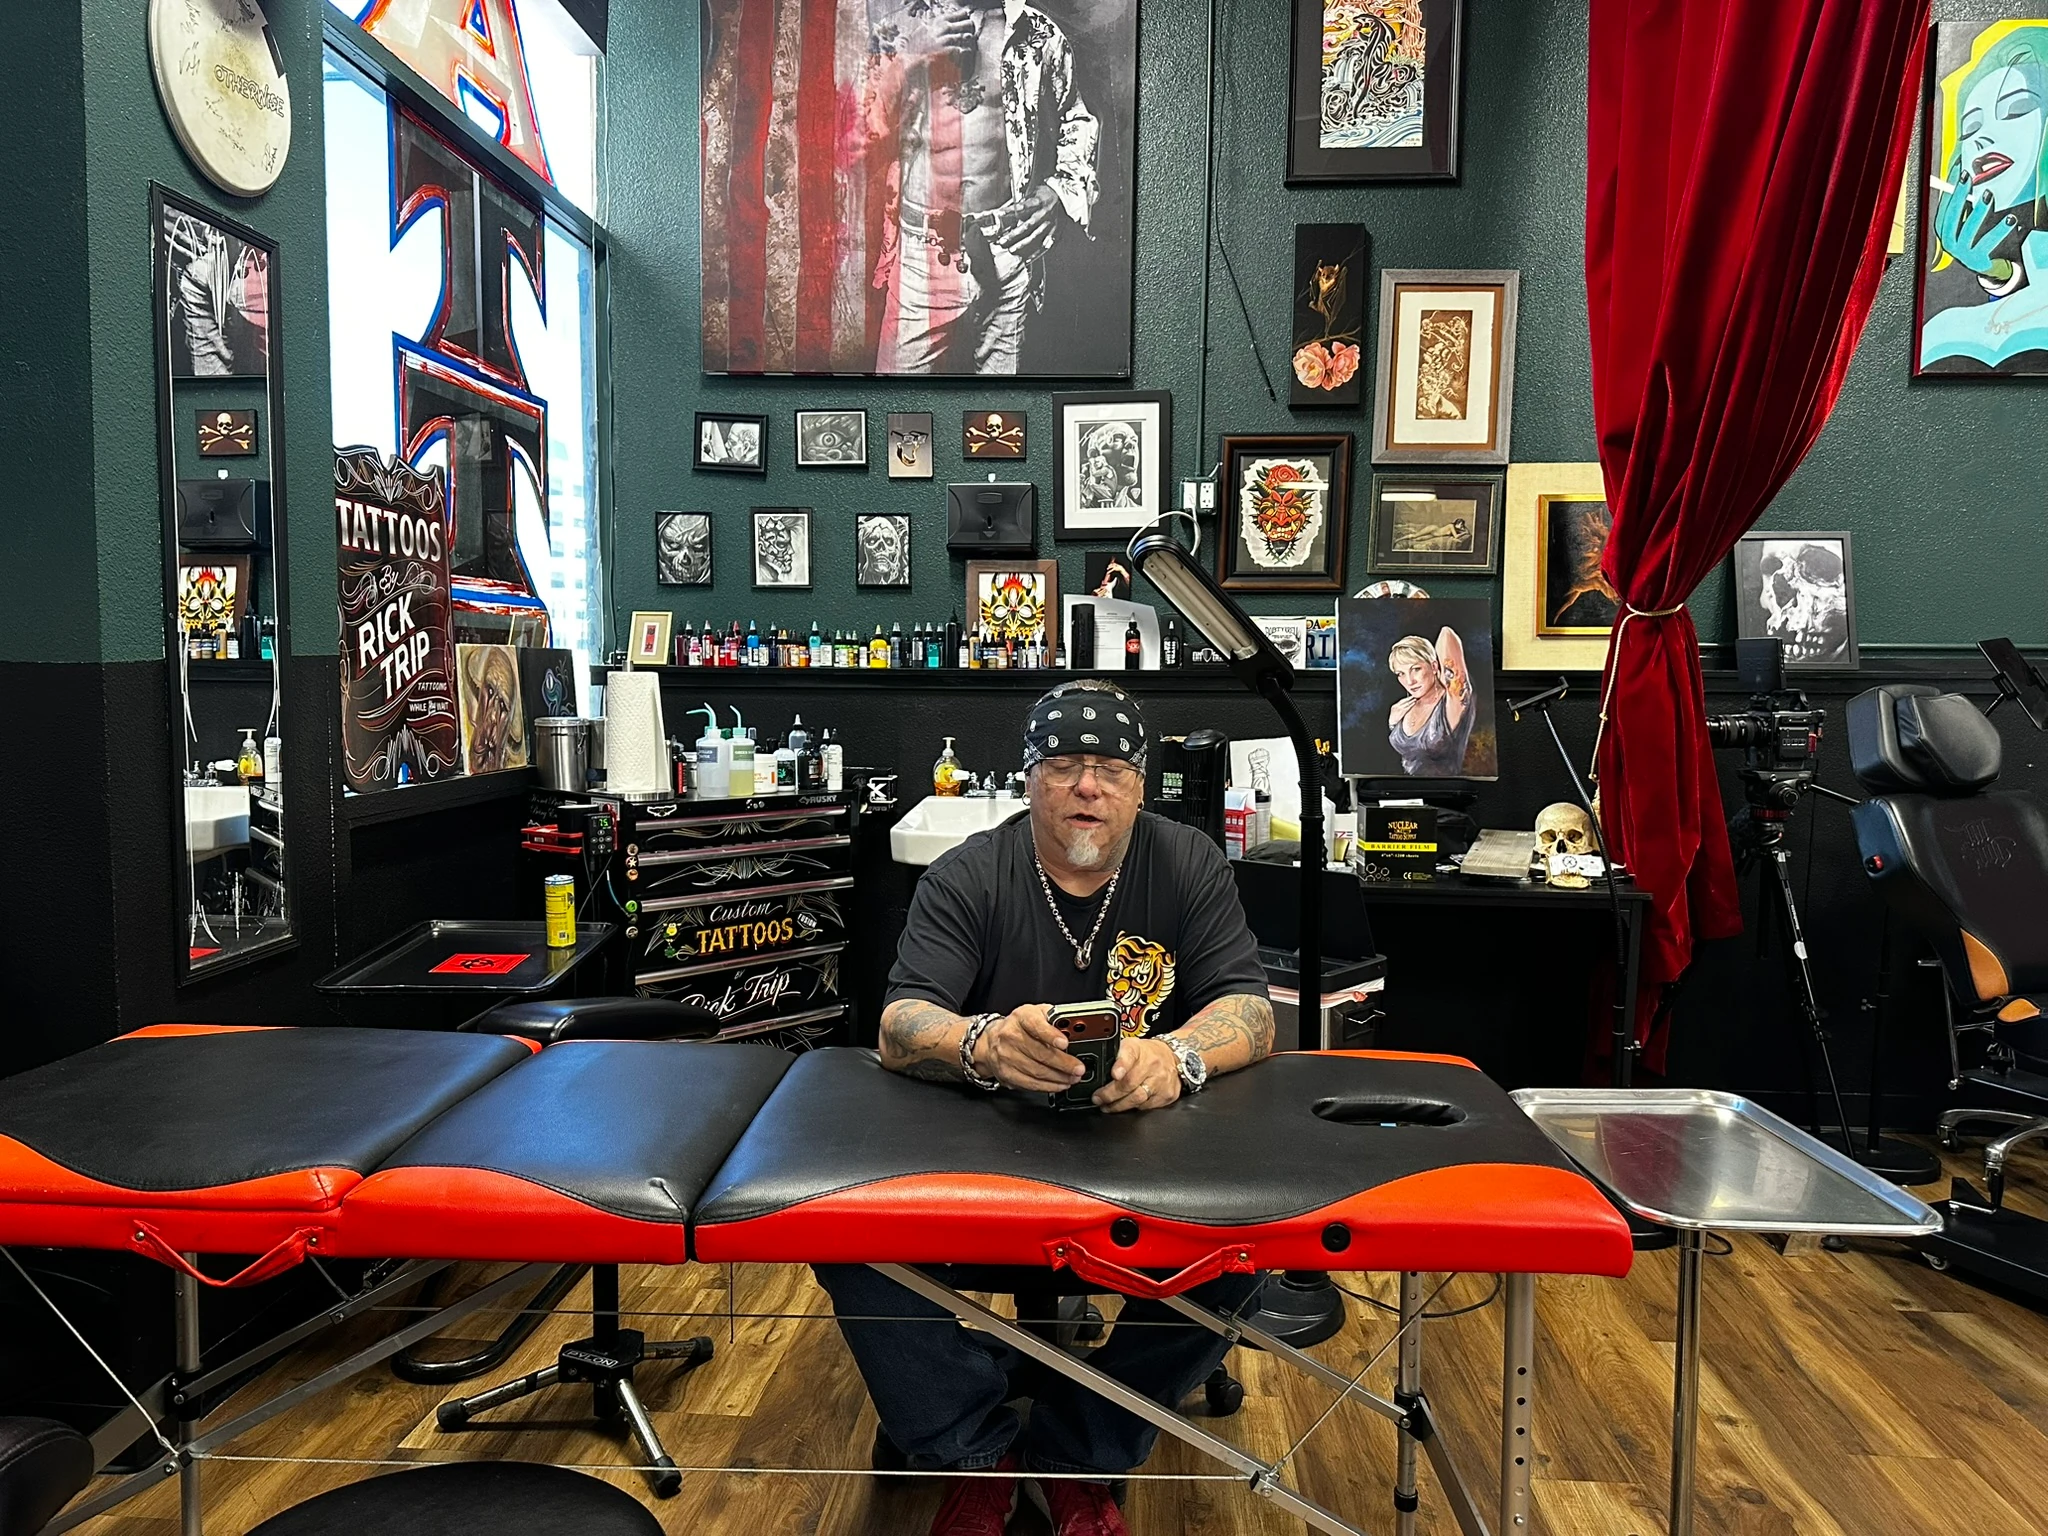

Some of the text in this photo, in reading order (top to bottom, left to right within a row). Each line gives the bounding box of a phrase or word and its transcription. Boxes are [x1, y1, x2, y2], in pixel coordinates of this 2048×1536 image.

[213, 64, 285, 118] OTHERWISE
[335, 497, 441, 562] TATTOOS
[379, 564, 403, 595] By
[358, 591, 416, 669] RICK
[380, 630, 430, 700] TRIP
[1388, 821, 1418, 830] NUCLEAR
[710, 901, 783, 922] Custom
[697, 918, 793, 954] TATTOOS
[744, 967, 790, 1006] Trip
